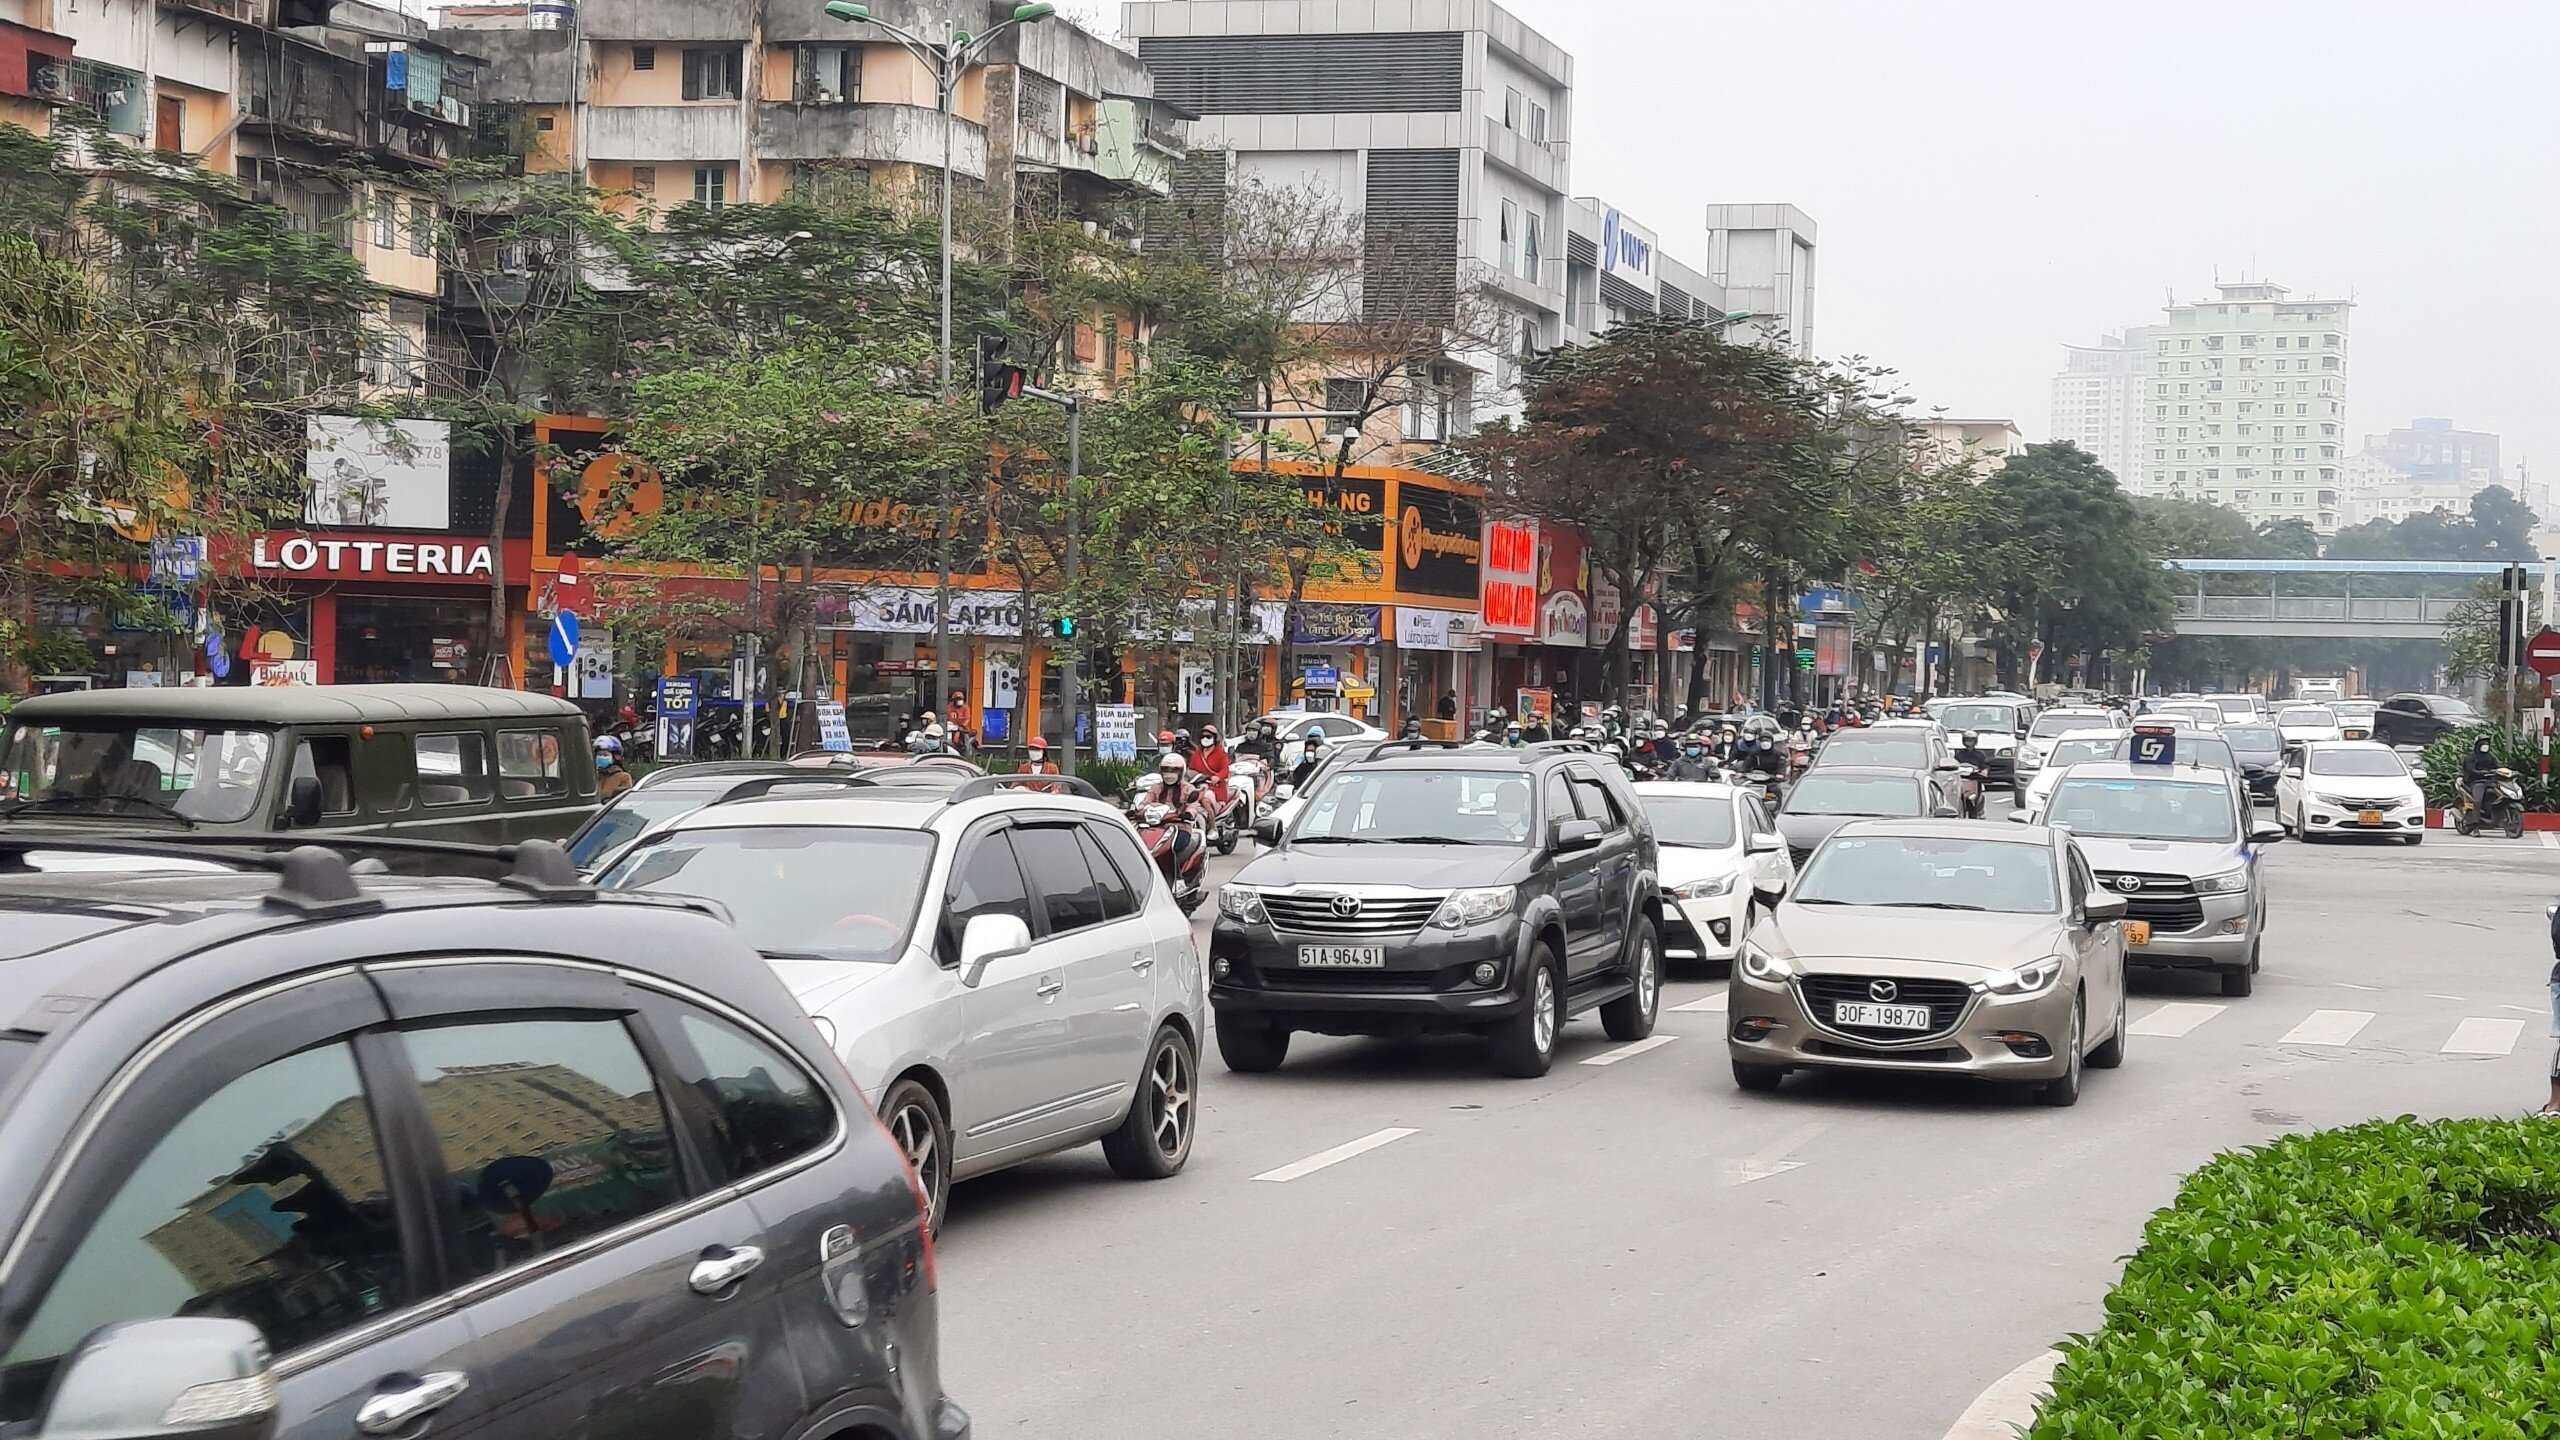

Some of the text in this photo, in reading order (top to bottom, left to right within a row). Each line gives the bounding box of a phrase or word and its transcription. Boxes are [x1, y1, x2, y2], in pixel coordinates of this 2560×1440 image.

[1620, 228, 1652, 277] VNPT
[253, 537, 493, 575] LOTTERIA
[2139, 738, 2165, 761] G7
